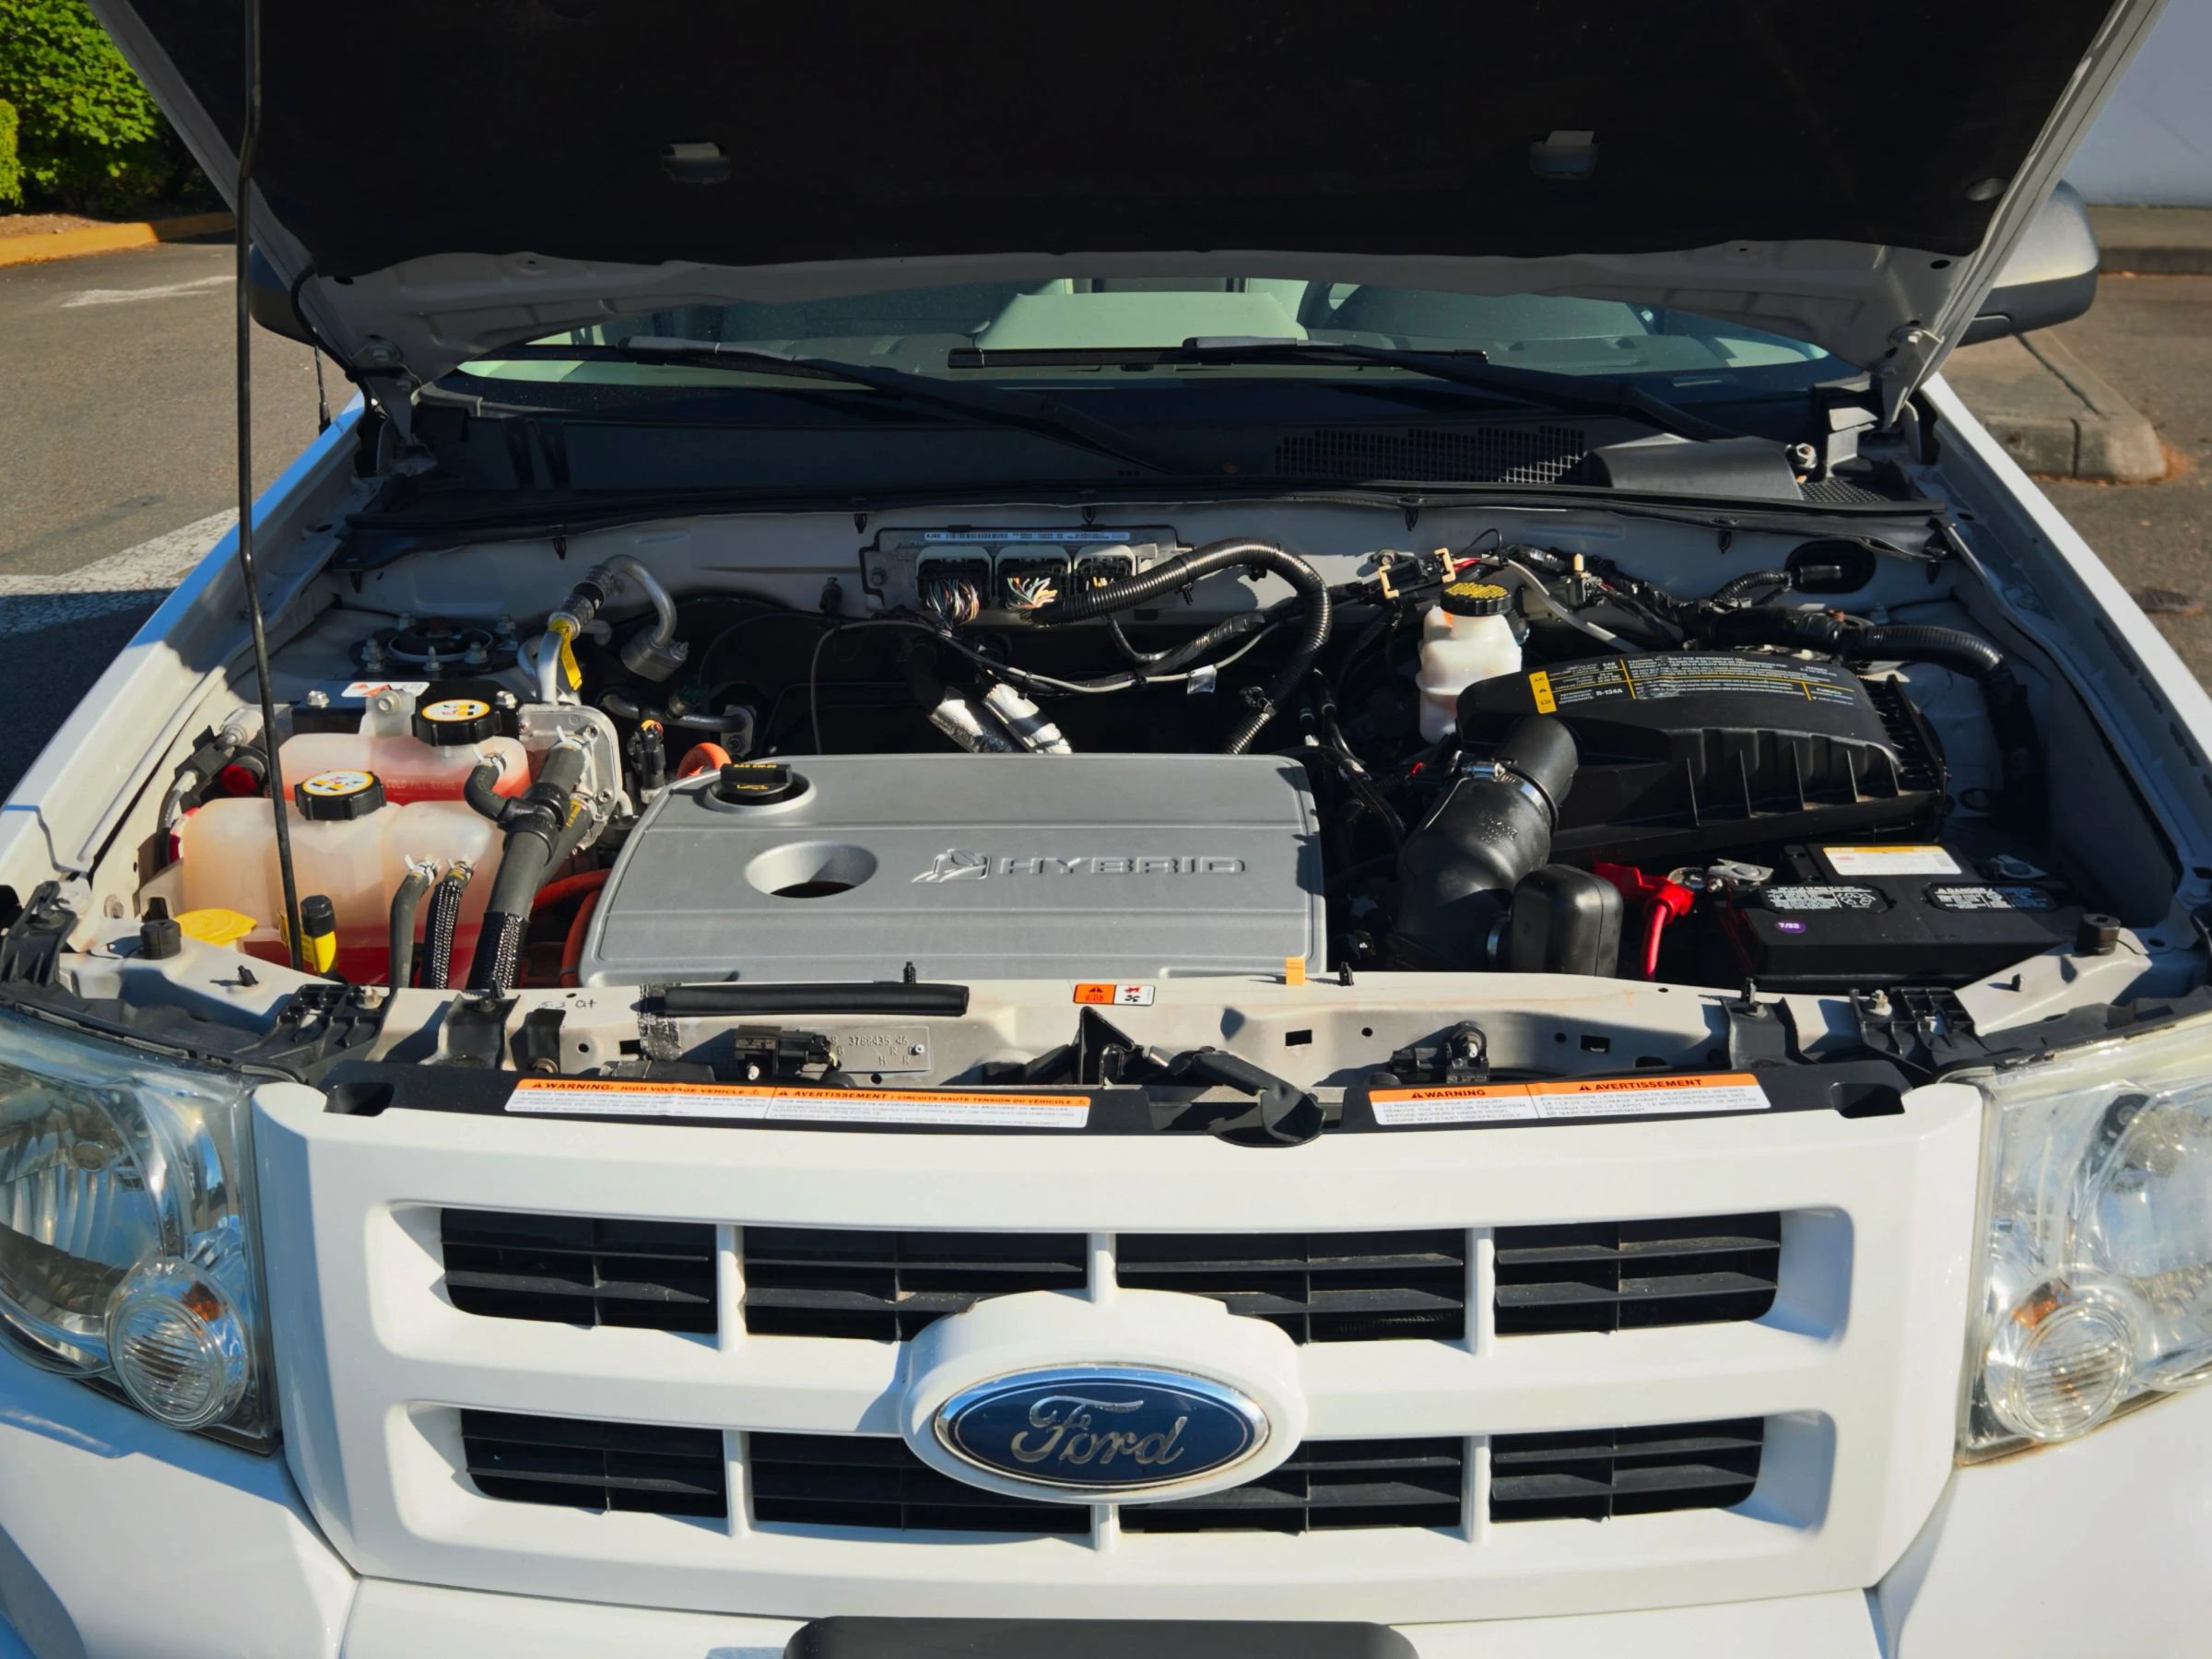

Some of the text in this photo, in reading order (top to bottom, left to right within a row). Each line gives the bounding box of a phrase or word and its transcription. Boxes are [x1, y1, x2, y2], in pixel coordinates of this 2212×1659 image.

[1595, 688, 1623, 696] R-134A
[385, 780, 406, 789] COLD
[998, 856, 1247, 876] HYBRID
[547, 1082, 614, 1091] WARNING:
[1594, 1079, 1702, 1091] AVERTISSEMENT
[794, 1090, 888, 1100] AVERTISSEMENT
[1425, 1089, 1487, 1099] WARNING
[1011, 1394, 1189, 1465] Ford
